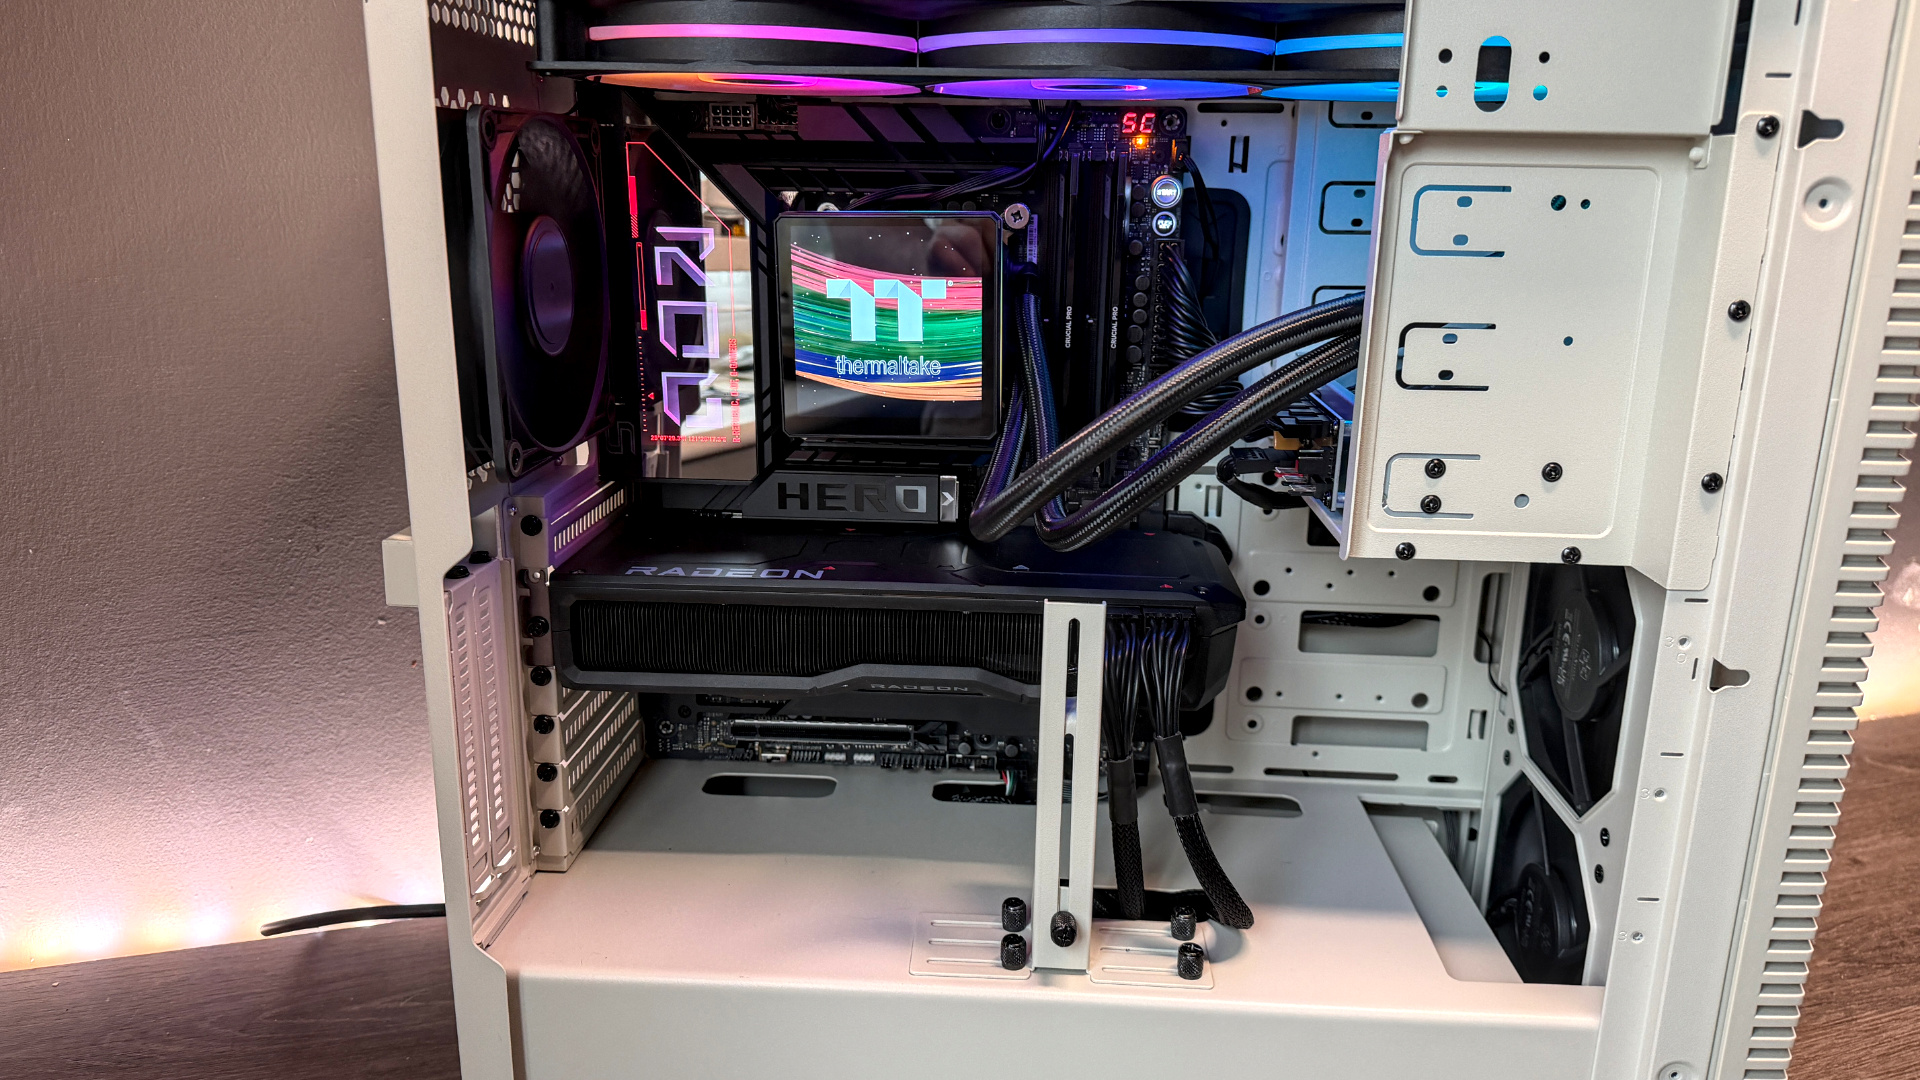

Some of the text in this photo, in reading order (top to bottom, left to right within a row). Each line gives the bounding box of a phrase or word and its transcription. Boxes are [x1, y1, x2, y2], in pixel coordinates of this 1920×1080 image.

[835, 355, 941, 376] thermaltake
[777, 482, 927, 513] HERO
[625, 566, 825, 580] RADEON
[870, 683, 968, 692] RADEON
